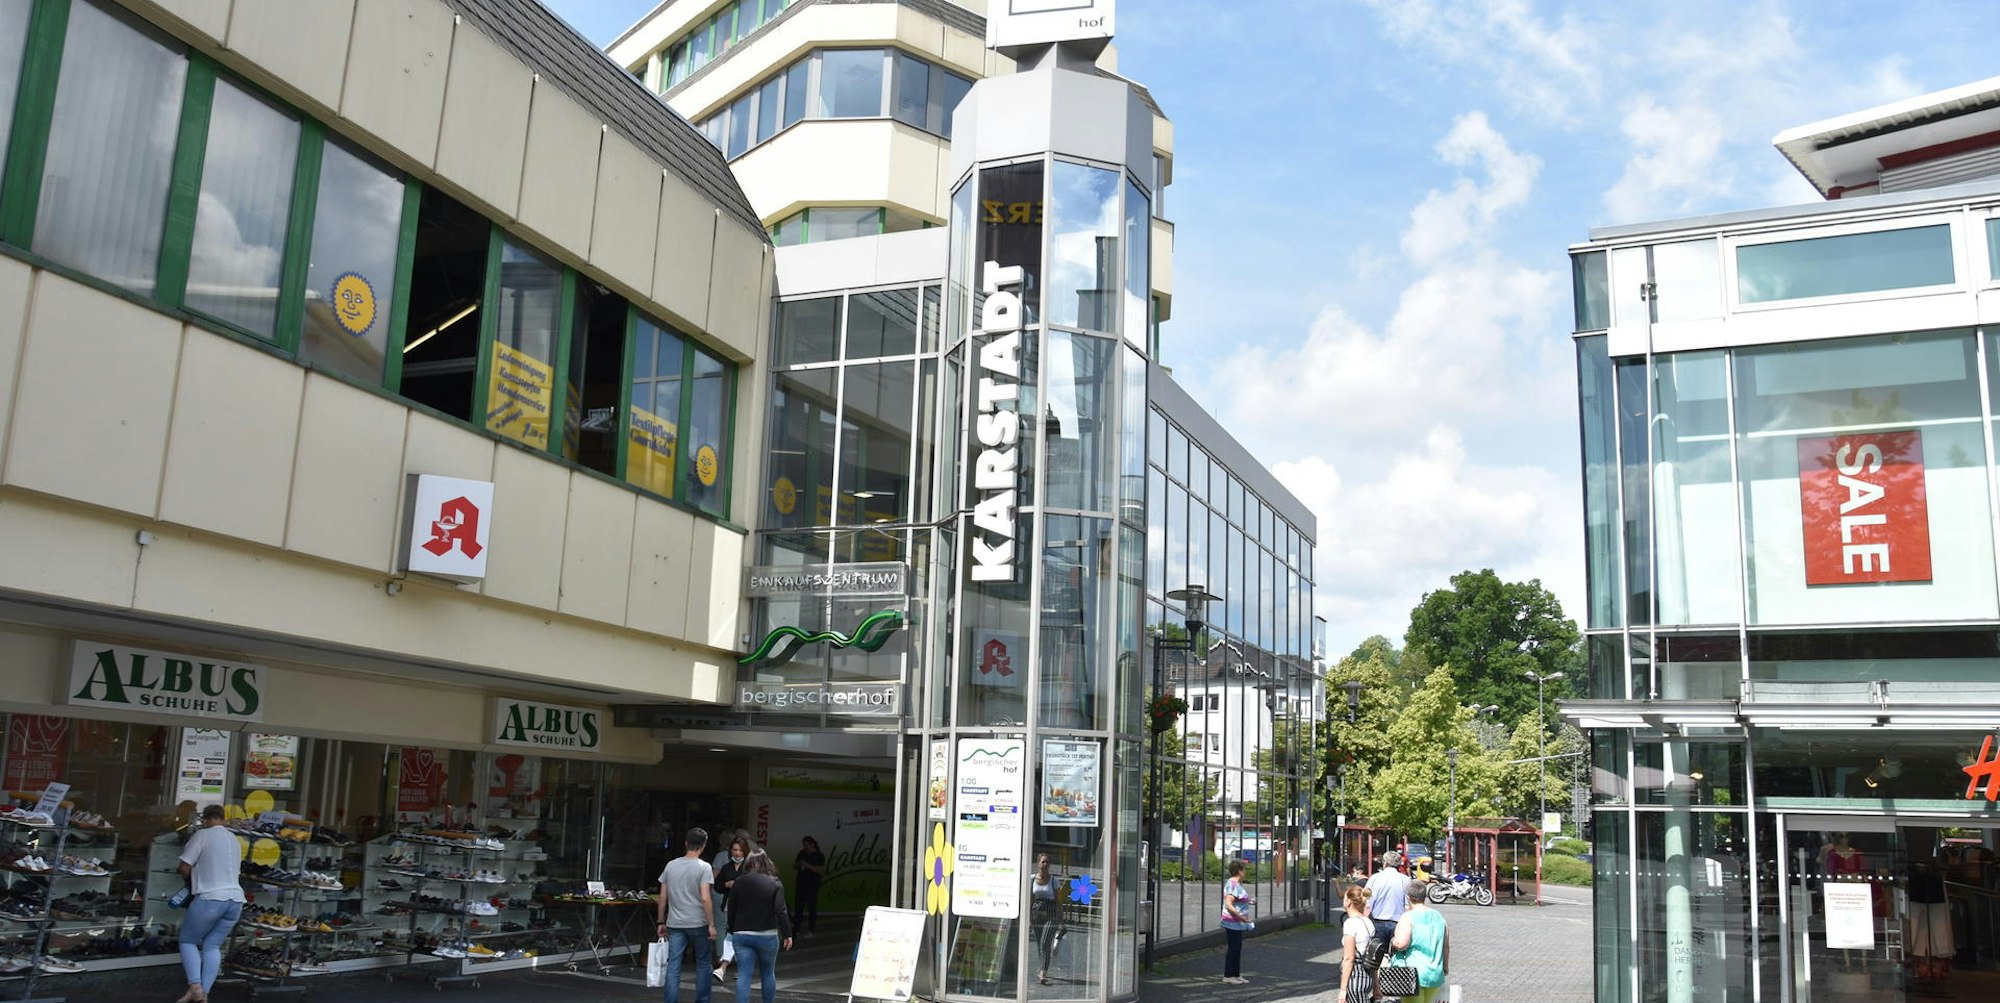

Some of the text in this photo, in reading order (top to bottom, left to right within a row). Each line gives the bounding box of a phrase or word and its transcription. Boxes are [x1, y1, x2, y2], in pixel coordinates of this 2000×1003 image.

[1078, 16, 1106, 29] hof
[972, 260, 1024, 582] KARSTADT
[1835, 443, 1891, 575] SALE
[750, 572, 898, 590] EINKAUFSZENTRUM
[73, 649, 259, 716] ALBUS
[140, 693, 218, 712] SCHUHE
[498, 703, 599, 748] ALBUS
[532, 734, 576, 747] SCHUHE
[972, 757, 1018, 767] bergischer
[1003, 766, 1018, 774] hof
